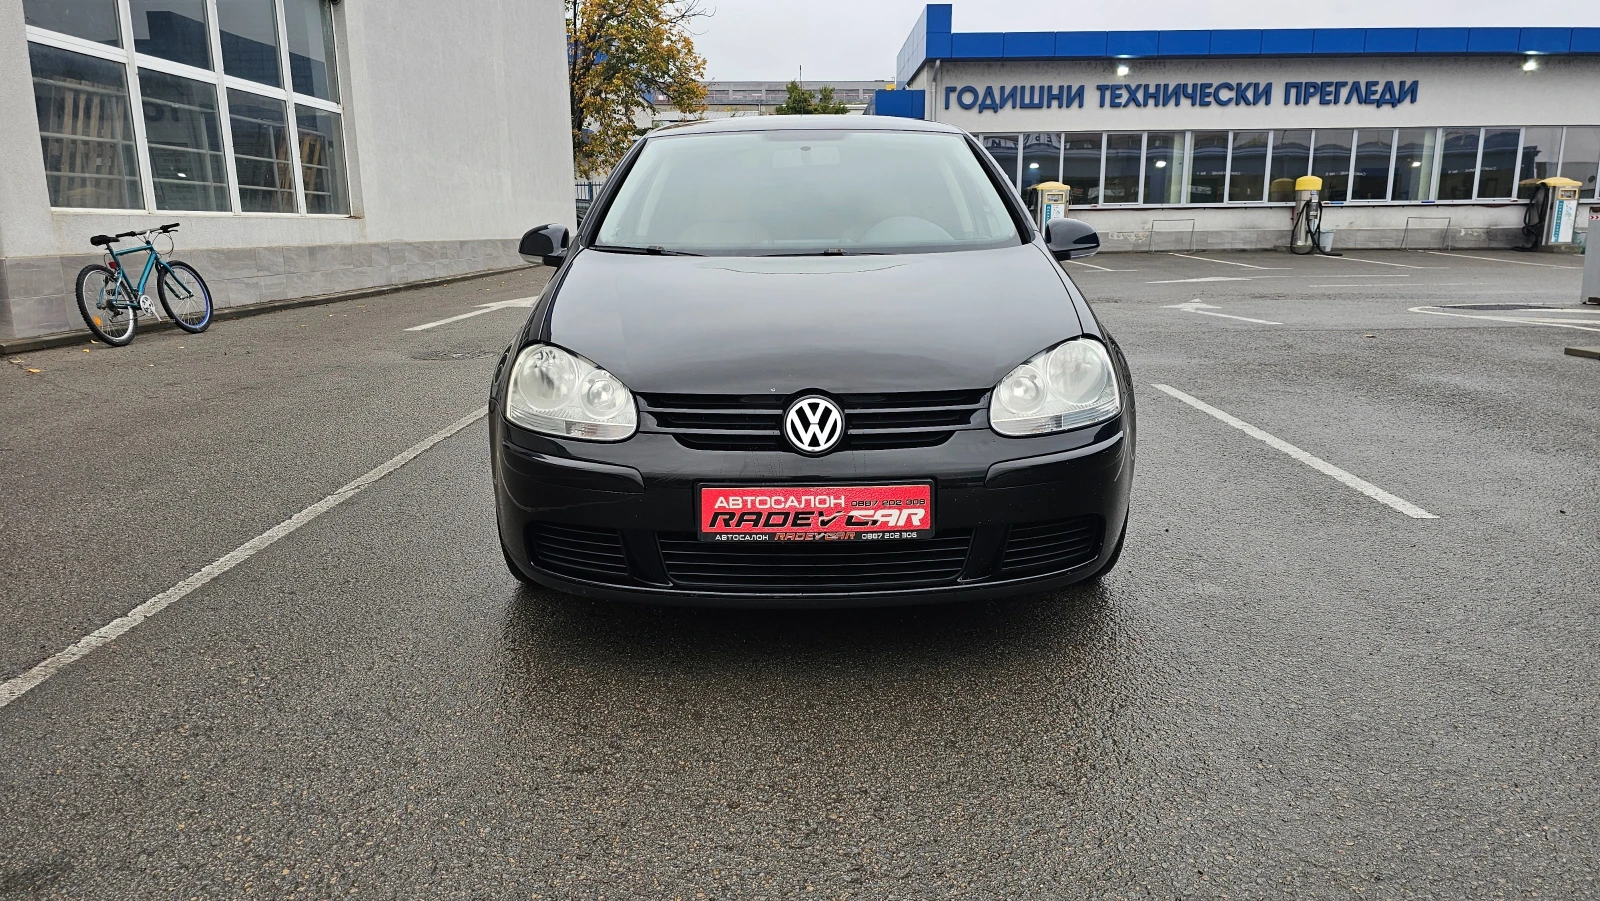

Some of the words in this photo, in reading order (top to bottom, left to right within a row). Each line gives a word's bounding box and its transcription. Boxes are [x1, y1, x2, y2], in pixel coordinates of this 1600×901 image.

[944, 84, 1086, 114] ГОДИШНИ
[1096, 81, 1274, 108] ТЕХНИЧЕСКИ
[1284, 80, 1419, 109] ПРЕГЛЕДИ
[714, 495, 845, 509] АВТОСАЛОН
